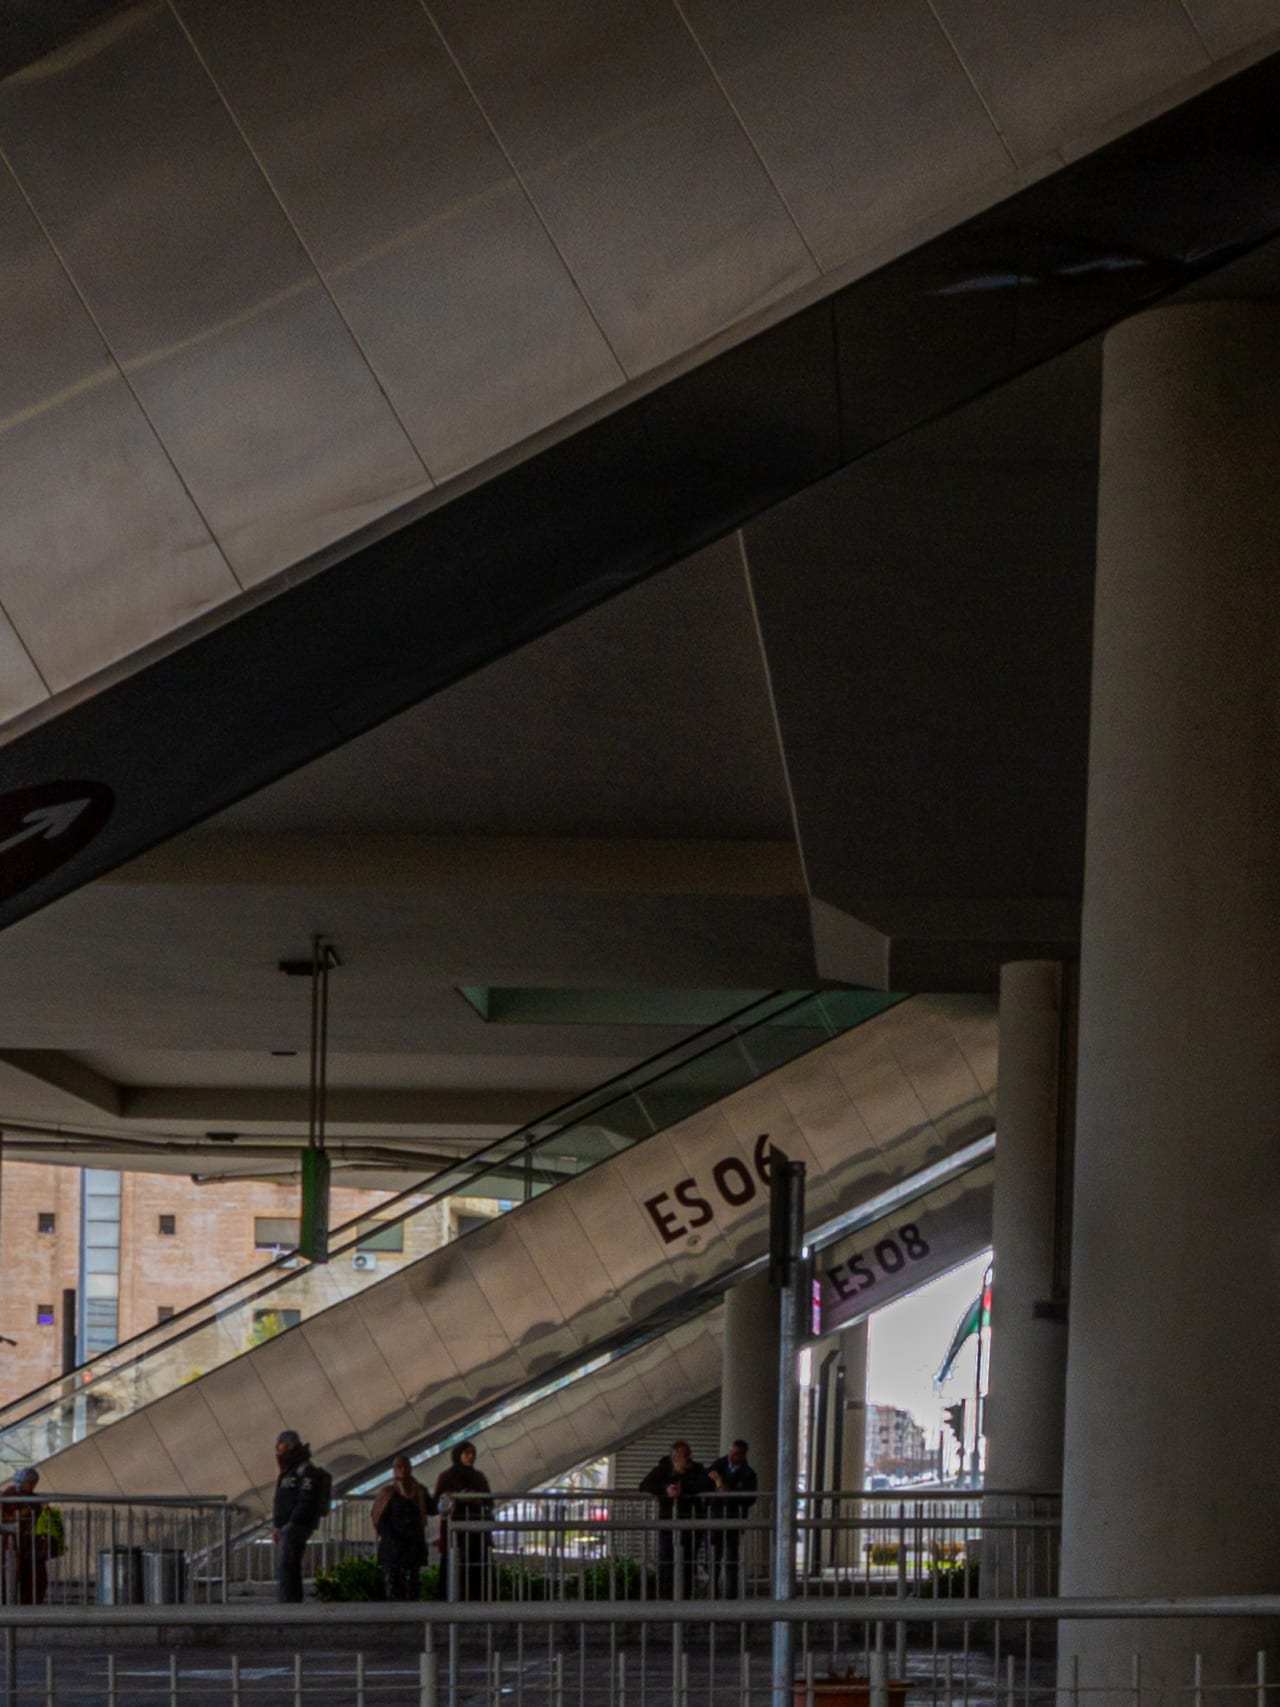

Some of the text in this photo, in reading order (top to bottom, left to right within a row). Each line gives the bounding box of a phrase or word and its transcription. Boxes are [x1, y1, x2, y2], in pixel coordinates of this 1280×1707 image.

[644, 1178, 714, 1244] ES
[826, 1223, 930, 1300] ES 08
